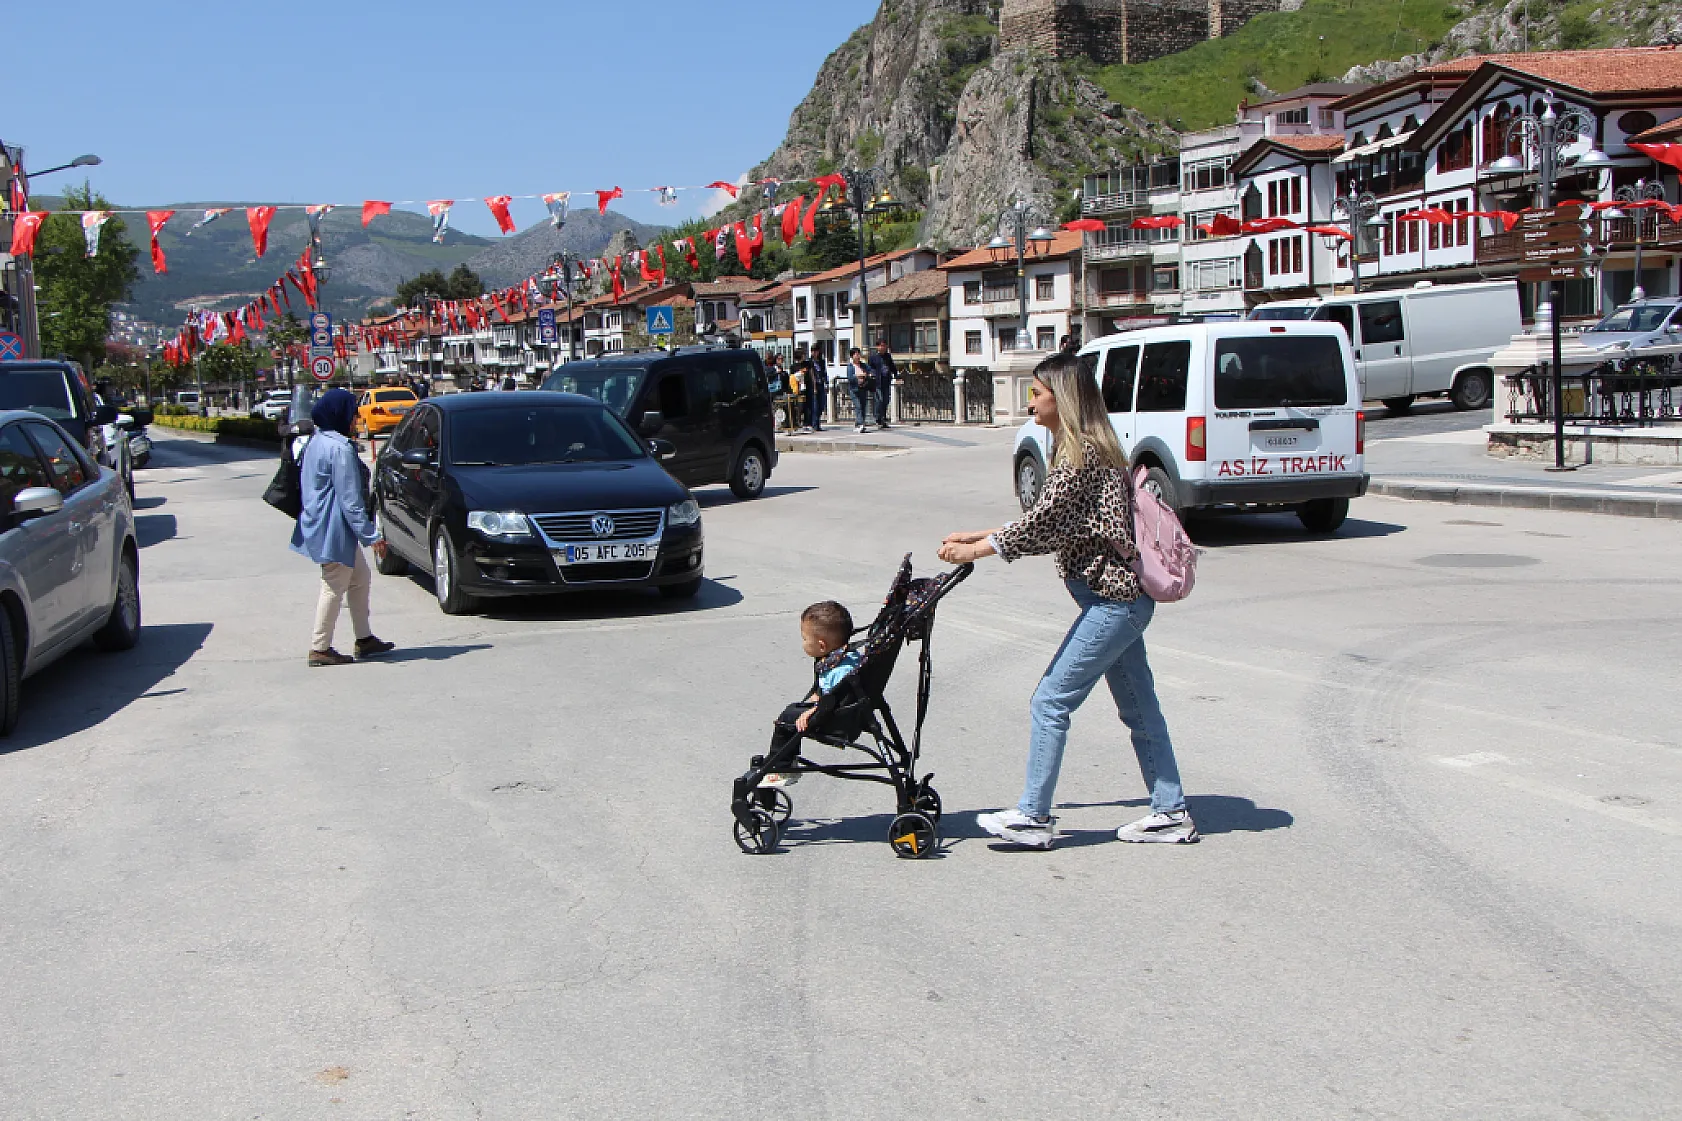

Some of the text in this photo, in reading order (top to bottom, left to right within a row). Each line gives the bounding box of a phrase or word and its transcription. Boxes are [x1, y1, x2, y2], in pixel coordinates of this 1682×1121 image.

[316, 362, 329, 373] 30
[1218, 452, 1346, 477] AS.İZ. TRAFİK
[575, 544, 645, 560] 05 AFC 205
